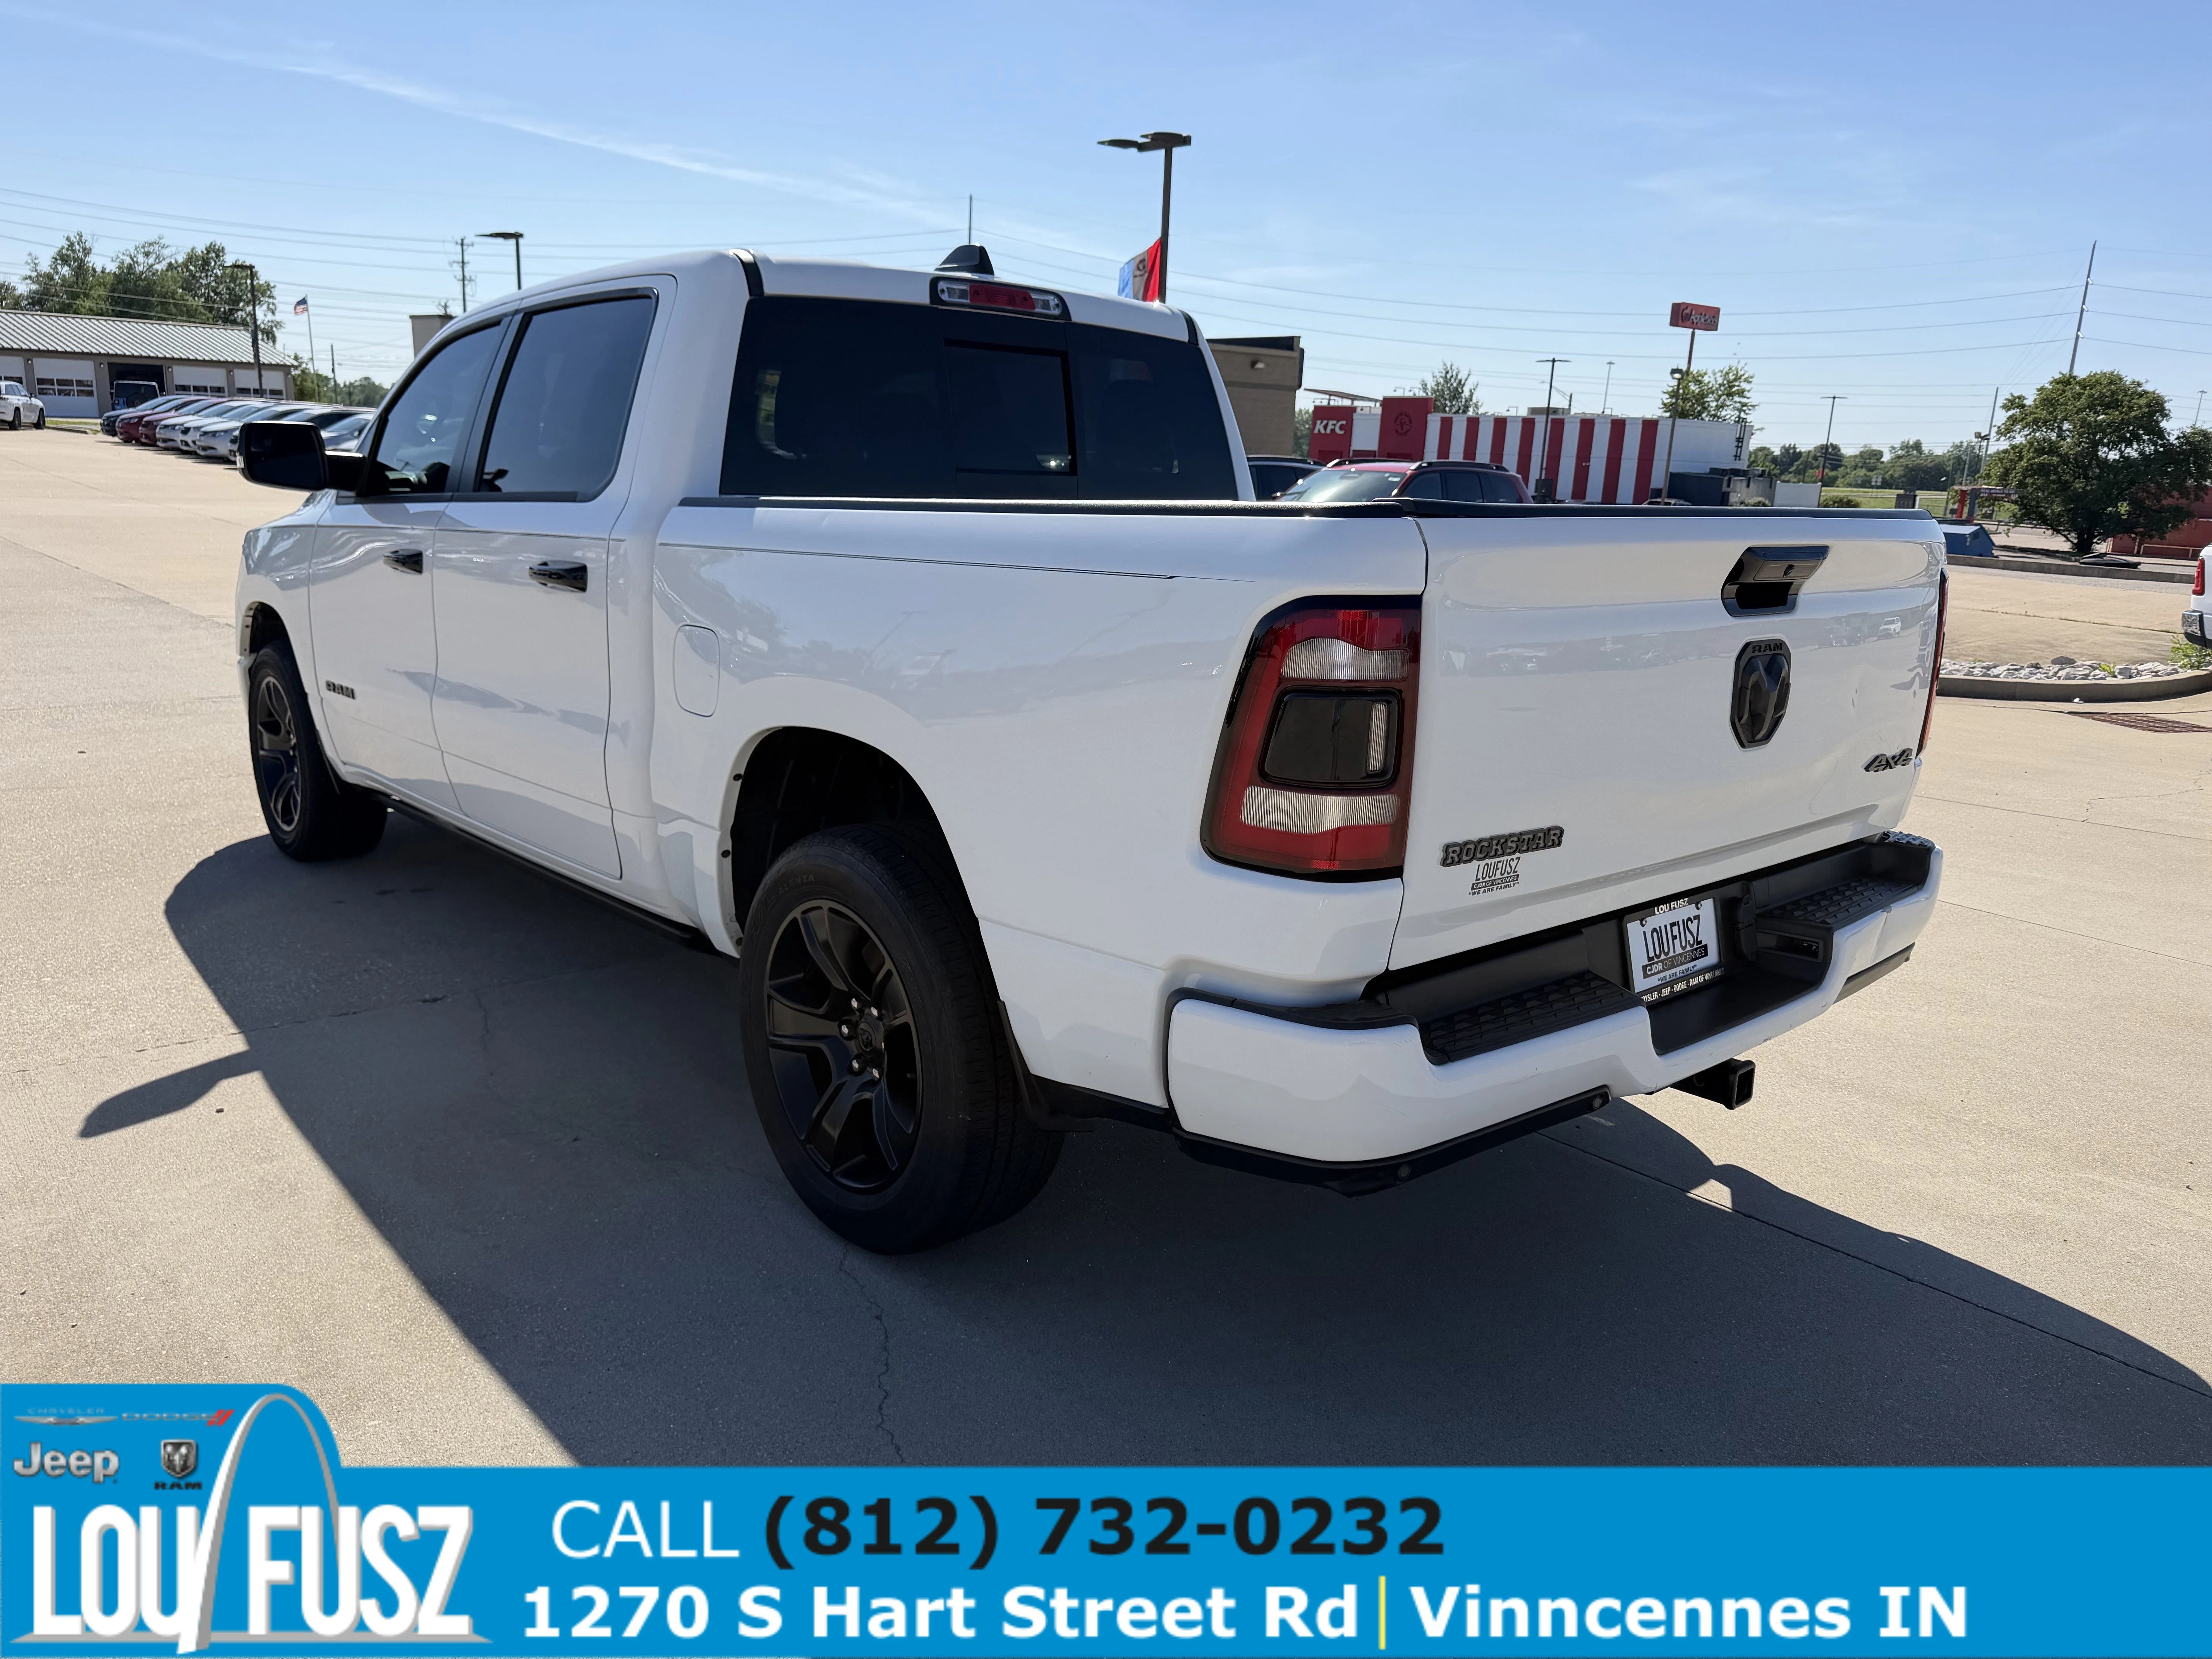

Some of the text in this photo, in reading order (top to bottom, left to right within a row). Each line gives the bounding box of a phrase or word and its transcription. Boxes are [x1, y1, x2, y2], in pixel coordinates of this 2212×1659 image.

[1313, 419, 1347, 434] KFC
[1752, 643, 1783, 654] RAM
[326, 680, 356, 699] RAM
[1443, 826, 1564, 867] ROCKSTAR
[1654, 898, 1689, 915] LOU FUSZ
[1646, 947, 1705, 975] CJDR OF VINCENNES
[1668, 971, 1678, 980] ARE
[1641, 991, 1658, 1003] RYSLER
[1661, 987, 1671, 997] JEEP
[1673, 981, 1687, 992] DODGE
[1689, 976, 1699, 986] RAM
[1698, 974, 1704, 983] OF
